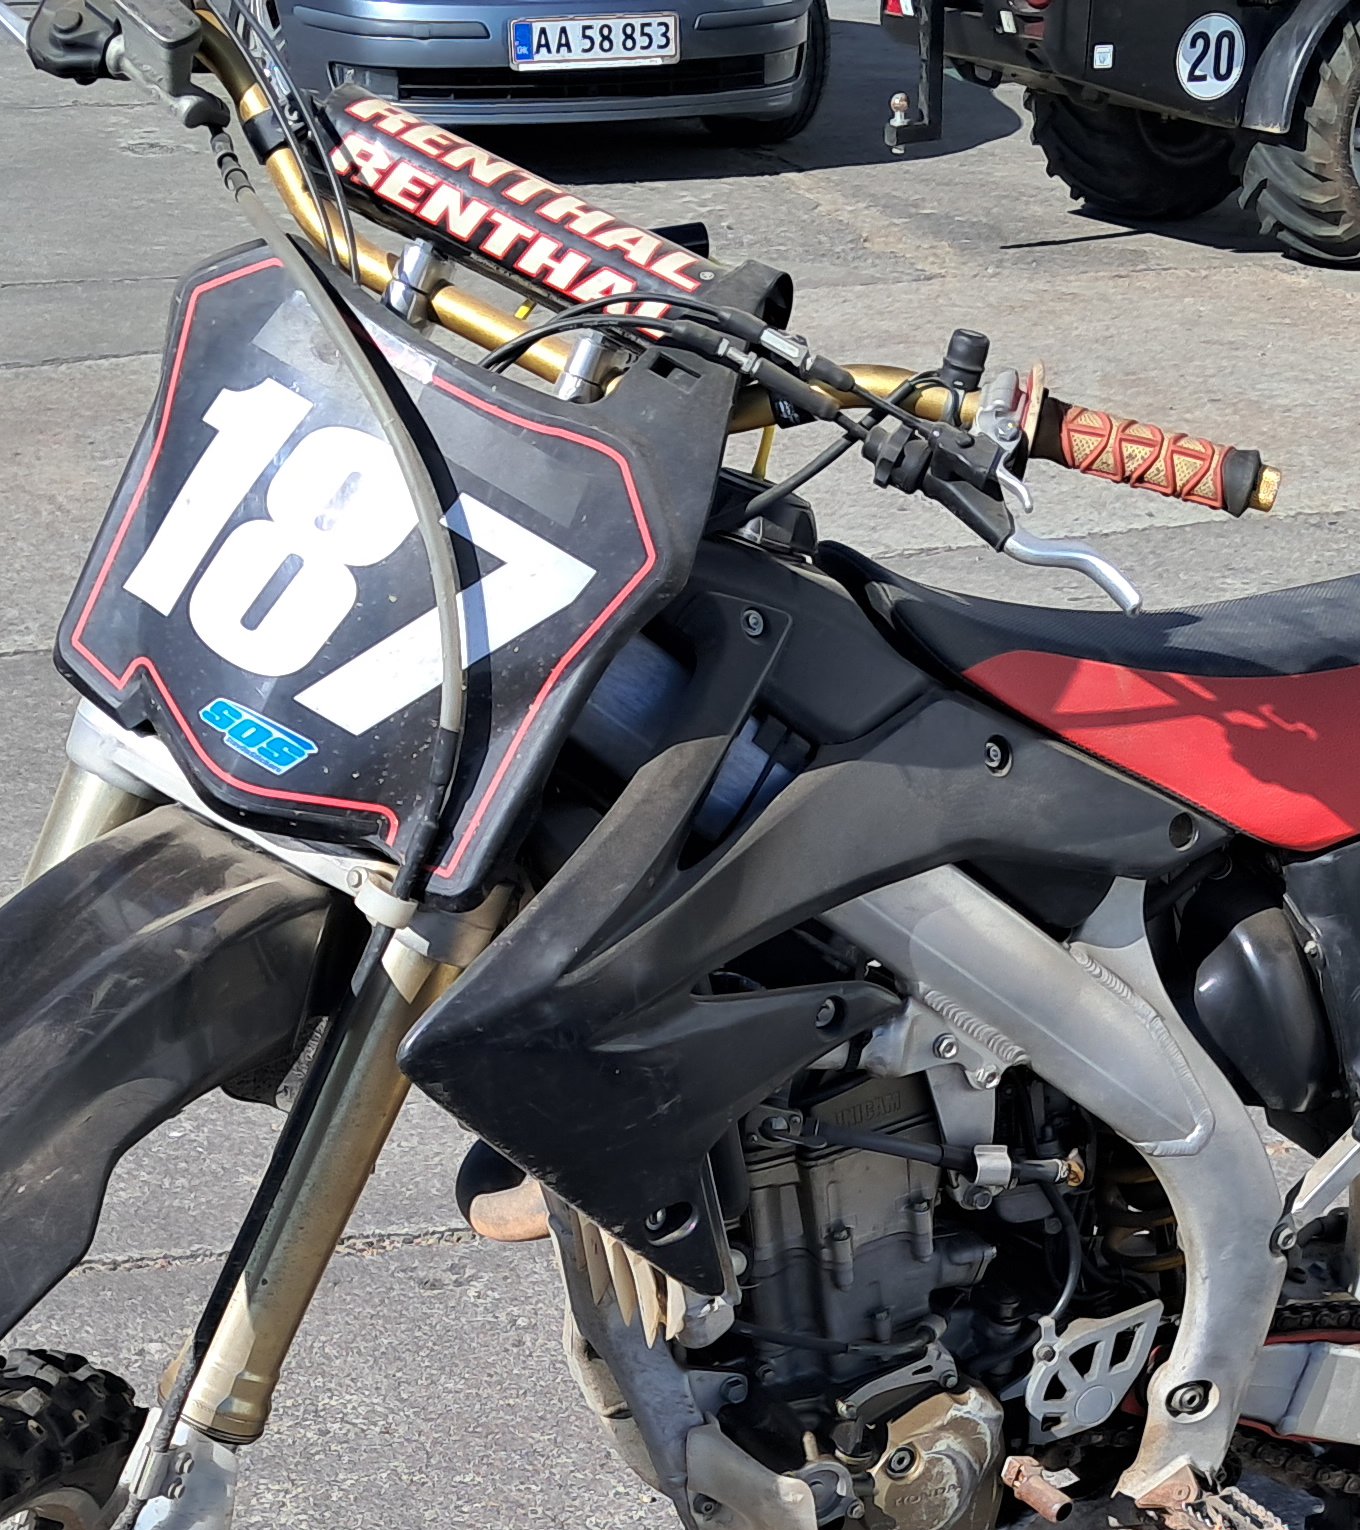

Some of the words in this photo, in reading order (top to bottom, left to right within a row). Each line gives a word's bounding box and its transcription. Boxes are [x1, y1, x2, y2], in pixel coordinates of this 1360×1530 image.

[534, 26, 572, 54] AA
[581, 24, 614, 53] 58
[621, 22, 671, 51] 853
[1187, 30, 1236, 82] 20
[344, 98, 702, 292] RENTHAL
[123, 377, 597, 736] 187
[201, 700, 307, 767] SOS
